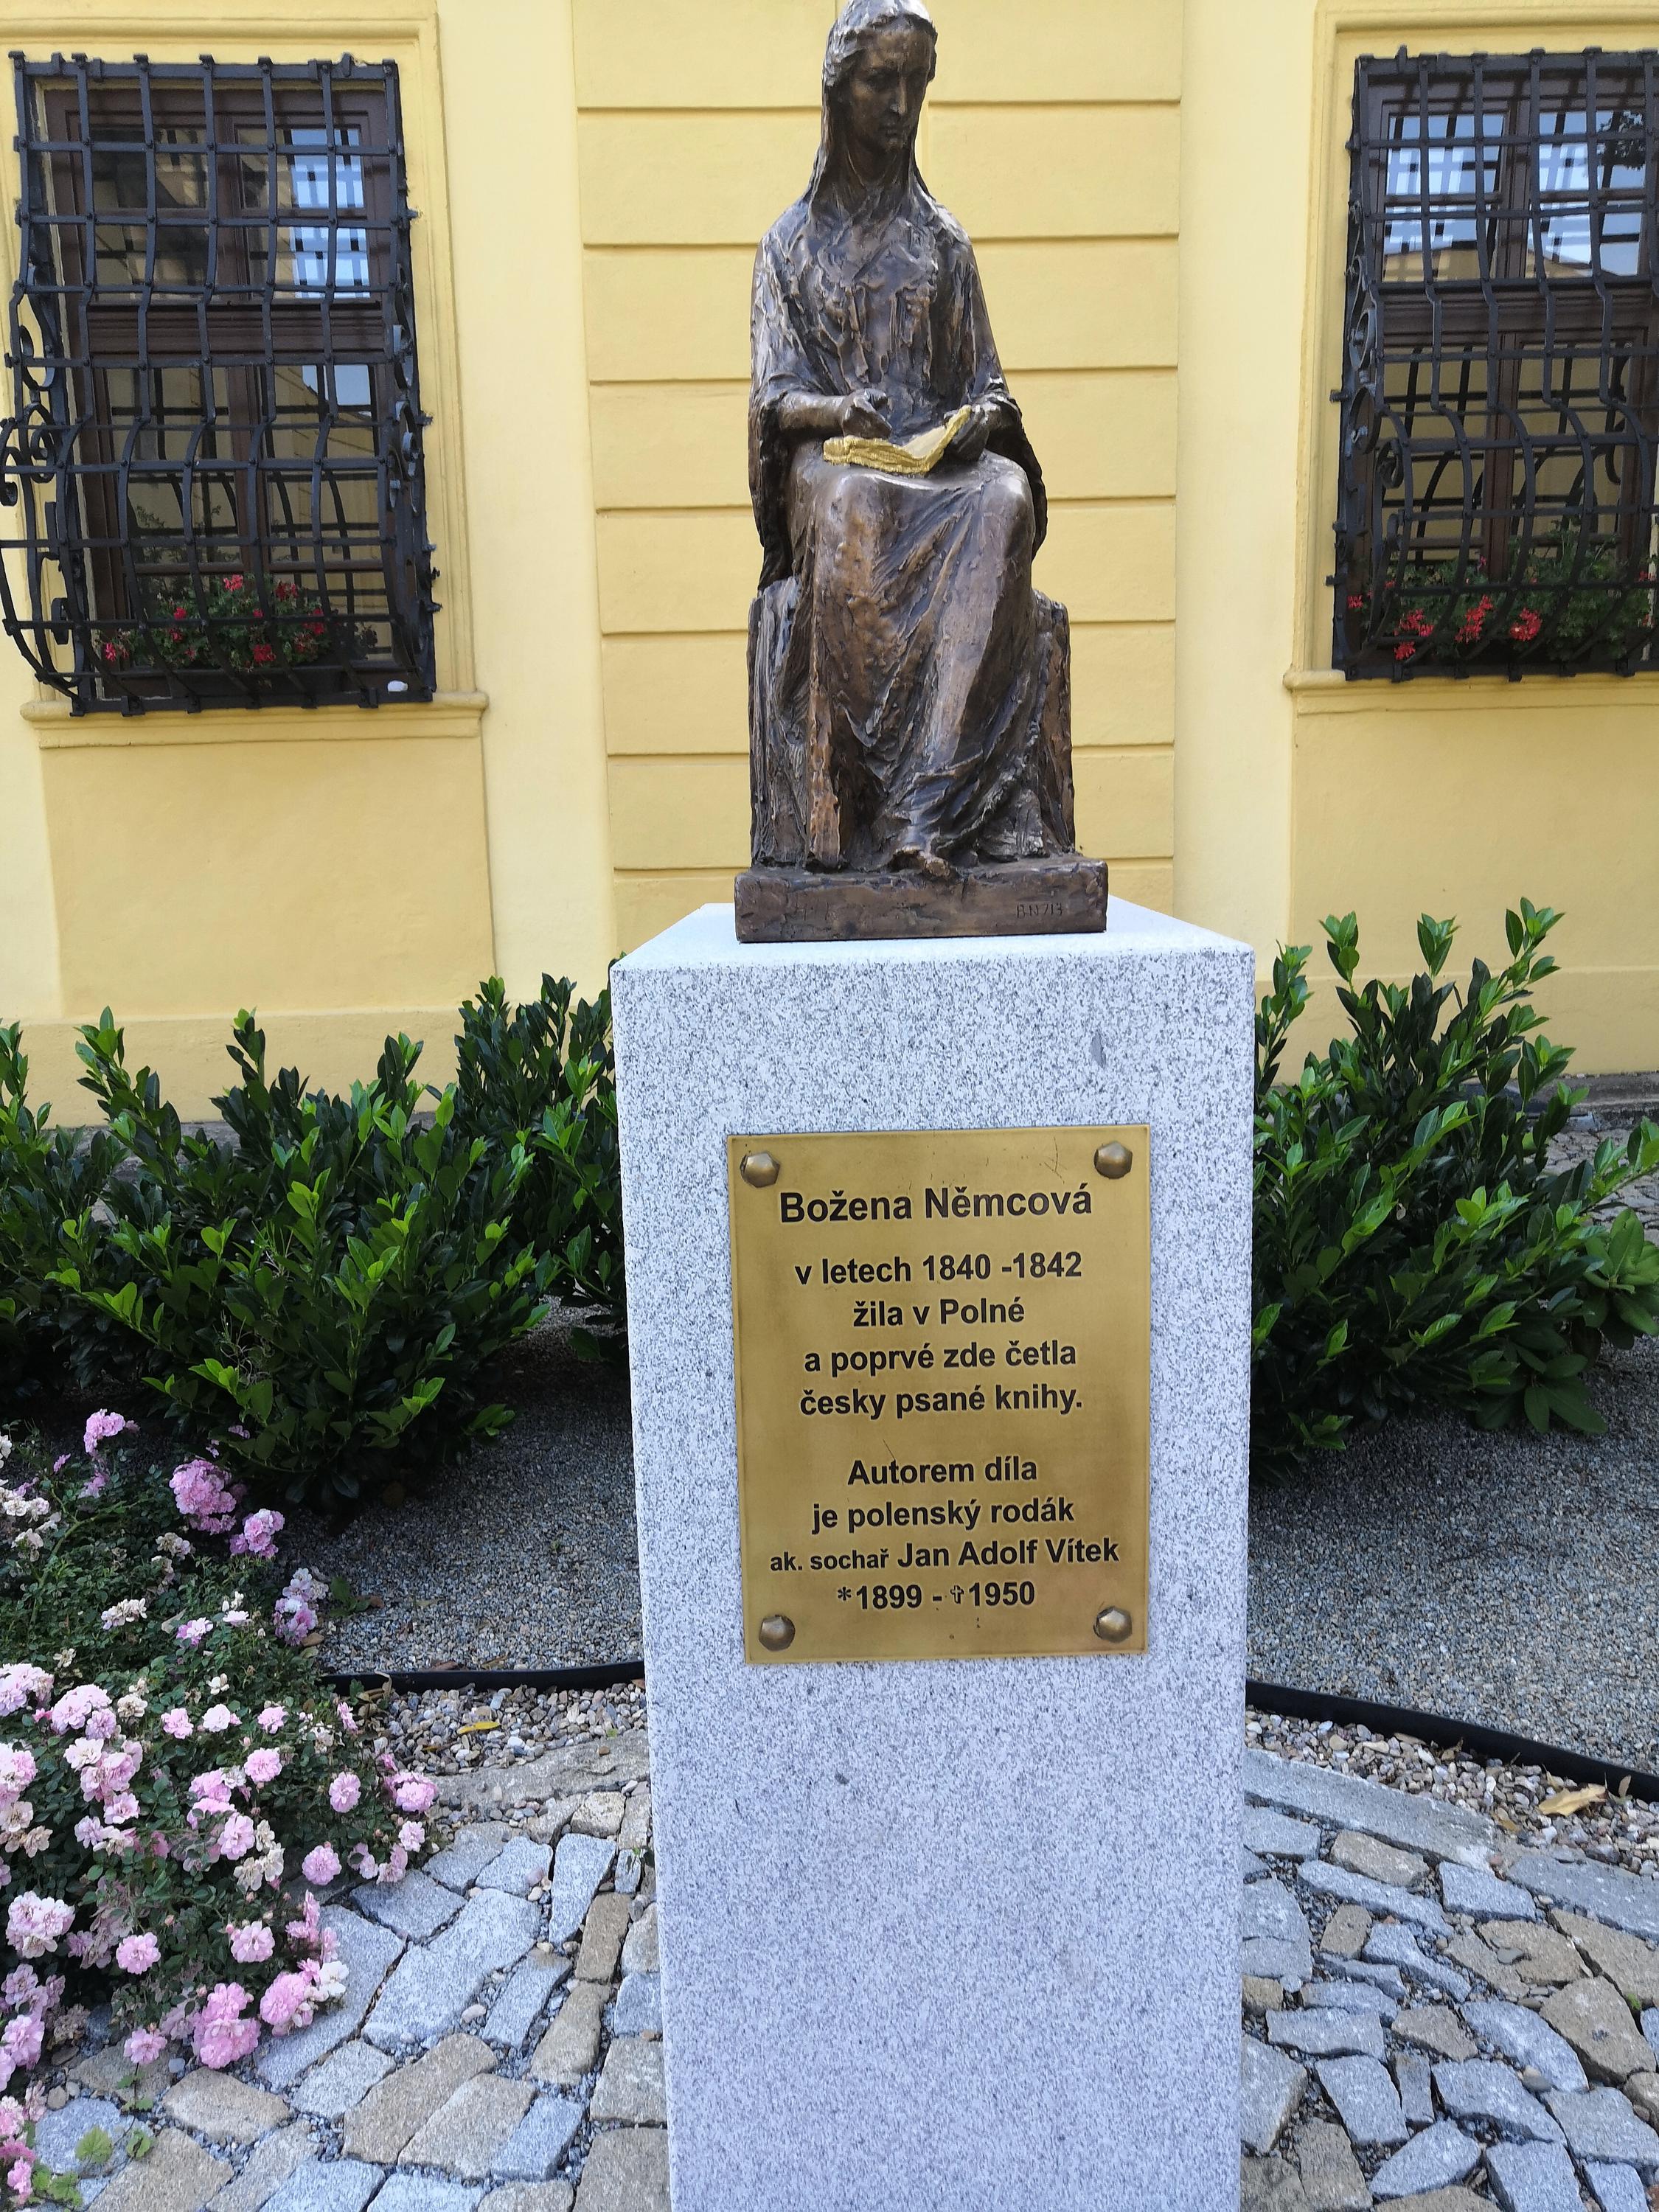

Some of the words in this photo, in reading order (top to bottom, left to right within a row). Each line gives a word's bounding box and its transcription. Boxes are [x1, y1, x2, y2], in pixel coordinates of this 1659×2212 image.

[780, 1190, 912, 1223] Božena
[925, 1183, 1092, 1218] Němcová
[794, 1265, 813, 1285] v
[822, 1256, 911, 1284] letech
[922, 1253, 991, 1281] 1840
[853, 1300, 903, 1327] žila
[912, 1306, 931, 1325] v
[940, 1296, 1025, 1325] Polné
[804, 1352, 821, 1372] a
[831, 1343, 934, 1378] poprvé
[943, 1341, 995, 1368] zde
[1005, 1340, 1076, 1366] četla
[800, 1388, 886, 1420] česky
[896, 1385, 985, 1419] psané
[995, 1383, 1082, 1414] knihy.
[847, 1458, 974, 1486] Autorem
[984, 1455, 1037, 1481] díla
[811, 1503, 838, 1535] je
[848, 1498, 981, 1534] polenský
[991, 1496, 1074, 1523] rodák
[770, 1551, 803, 1571] ak.
[810, 1548, 889, 1571] sochař
[897, 1543, 950, 1568] Jan
[958, 1539, 1038, 1566] Adolf
[1045, 1537, 1119, 1563] Vítek
